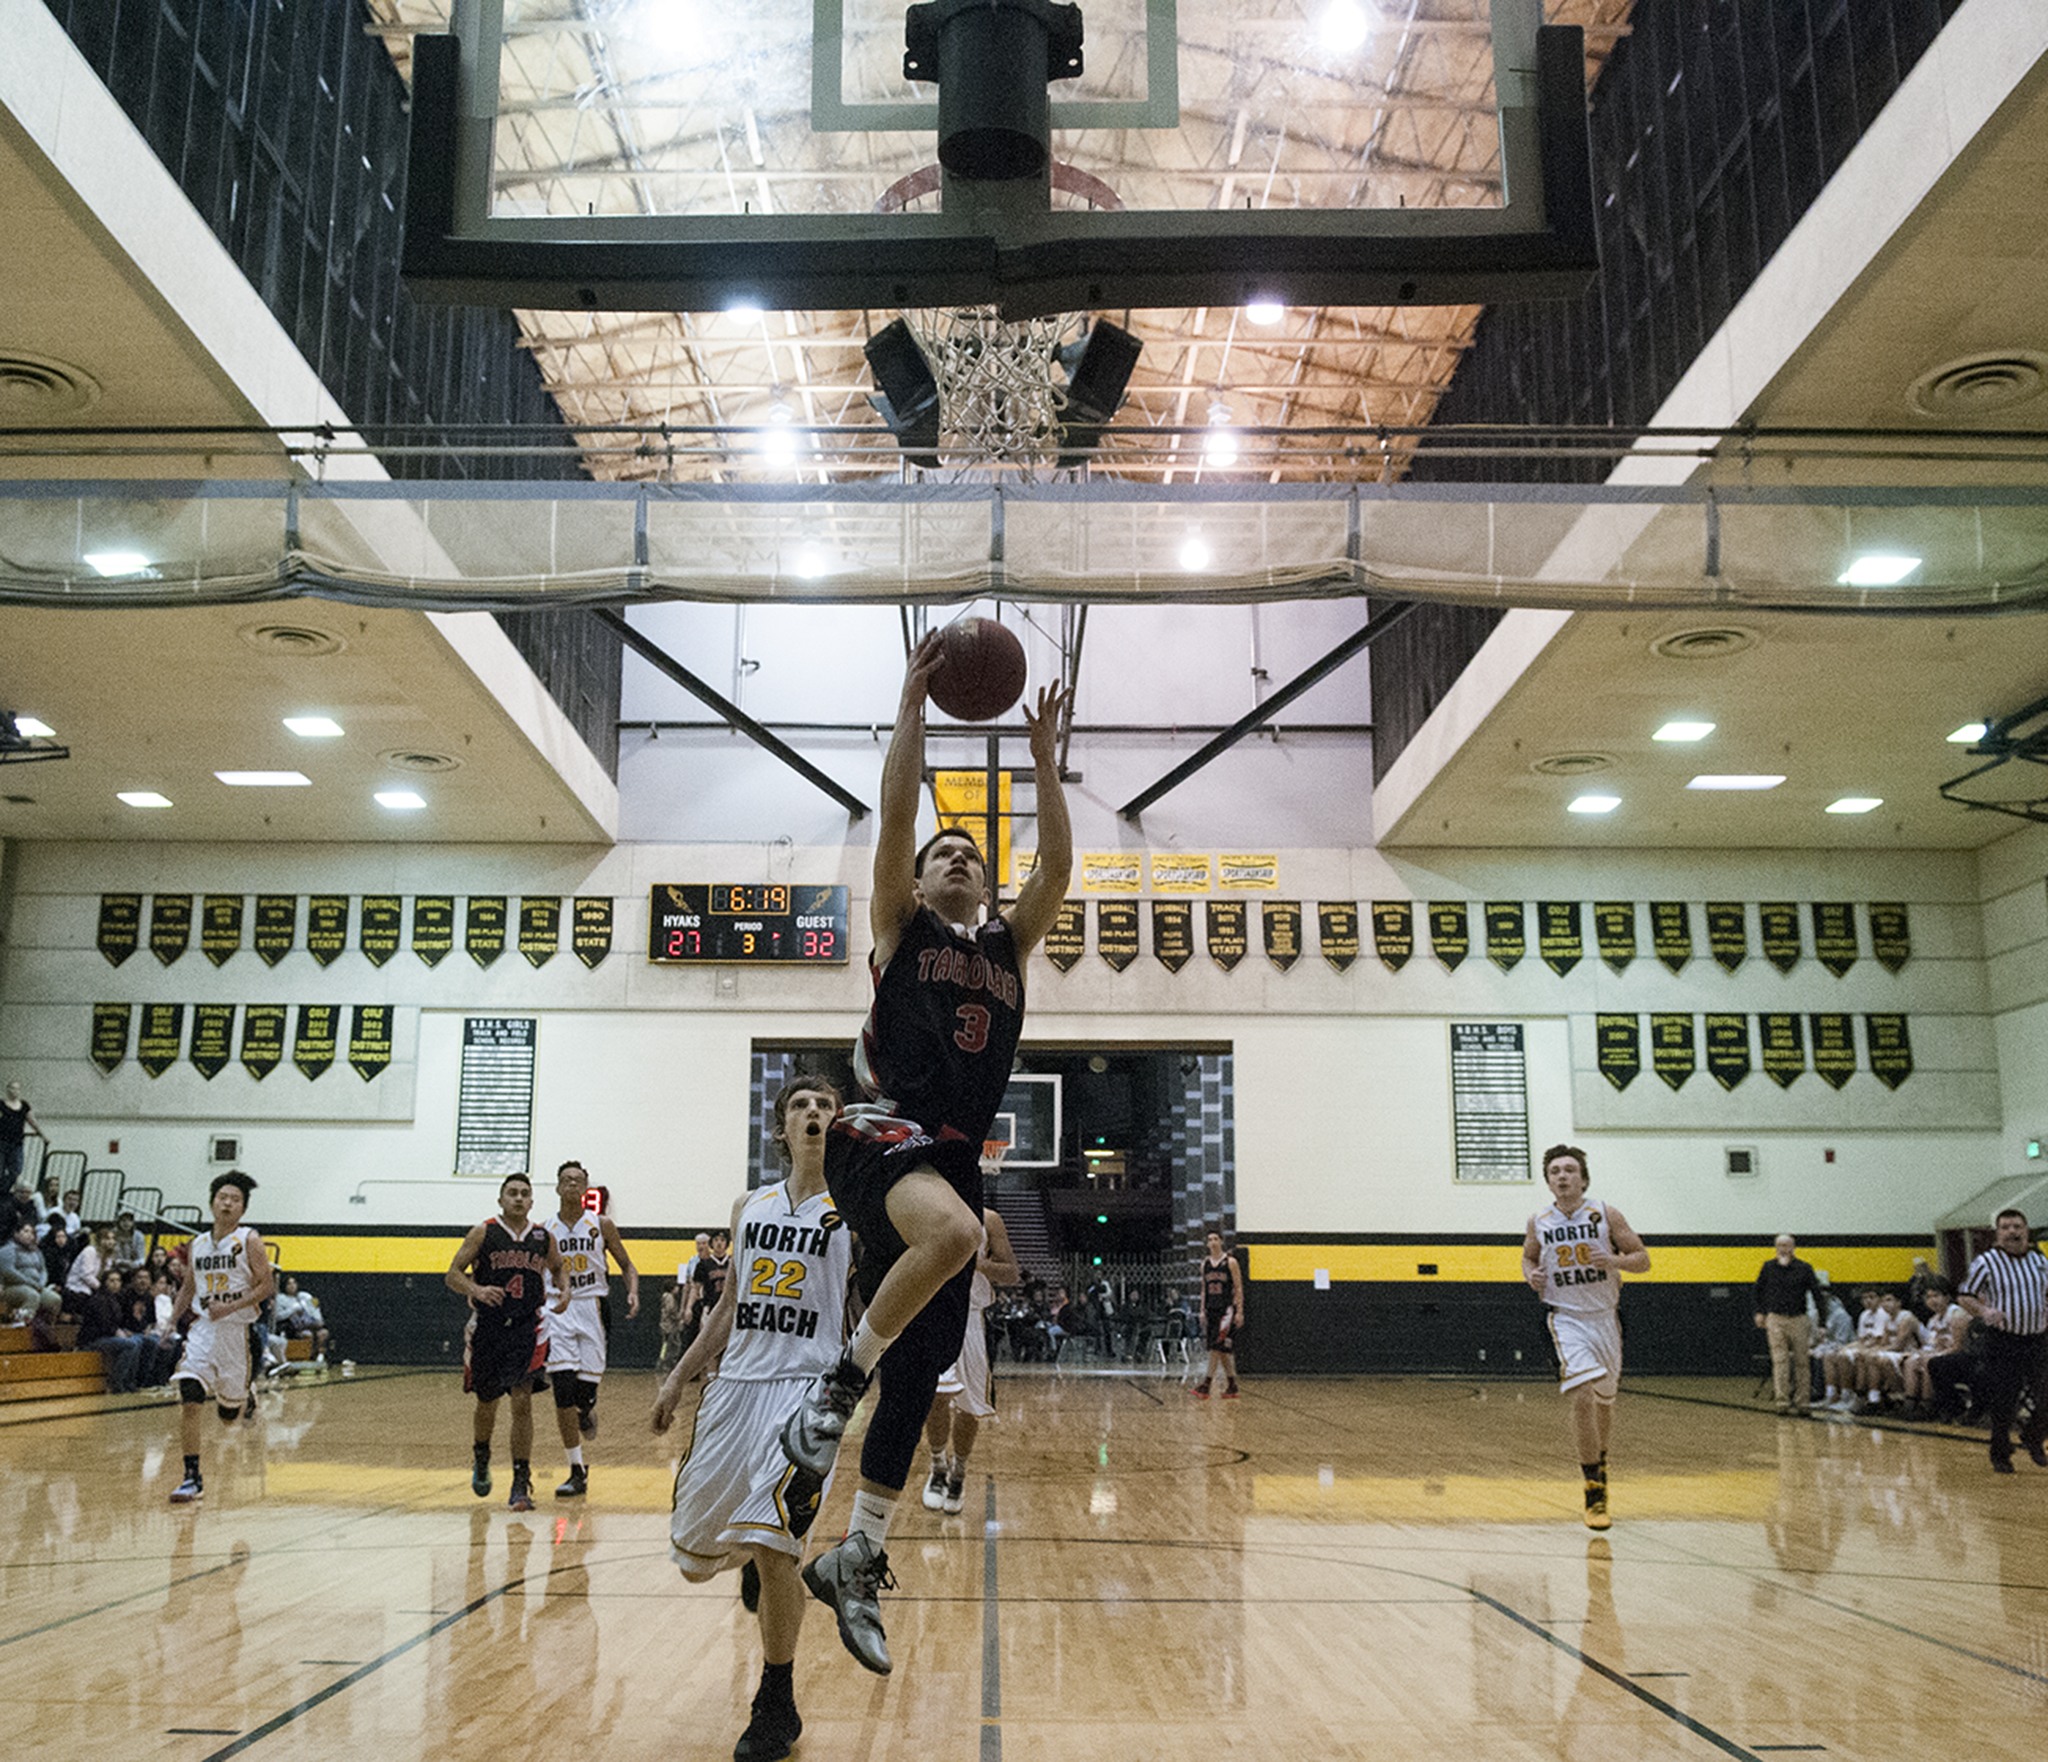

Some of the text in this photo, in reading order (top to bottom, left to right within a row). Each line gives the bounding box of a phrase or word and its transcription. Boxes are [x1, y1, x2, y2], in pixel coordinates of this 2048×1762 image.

[944, 777, 987, 787] MEMB
[730, 886, 785, 911] 6:19
[363, 899, 400, 911] FOOTBALL
[577, 900, 609, 911] SOFTBALL
[1100, 904, 1136, 914] BASEBALL
[1210, 904, 1242, 914] TRACK
[663, 914, 701, 927] HYAKS
[796, 915, 834, 928] GUEST
[590, 925, 611, 933] PLACE
[734, 921, 763, 932] PERIOD
[482, 928, 504, 936] PLACE
[534, 931, 556, 939] PLACE
[470, 938, 500, 948] STATE
[577, 937, 606, 947] STATE
[668, 930, 701, 956] 27
[1061, 934, 1082, 942] PLACE
[1542, 937, 1580, 946] DISTRICT
[311, 940, 341, 949] STATE
[364, 940, 394, 949] STATE
[412, 940, 451, 949] DISTRICT
[519, 942, 557, 952] DISTRICT
[743, 933, 755, 954] 3
[805, 931, 834, 956] 32
[1046, 945, 1083, 954] DISTRICT
[1099, 944, 1137, 954] DISTRICT
[1211, 945, 1242, 954] STATE
[1379, 945, 1408, 955] STATE
[308, 1008, 330, 1018] GOLF
[362, 1008, 384, 1018] GOLF
[506, 1020, 529, 1029] GIRLS
[954, 1003, 991, 1053] 3
[495, 1029, 508, 1037] AND
[297, 1040, 334, 1049] DISTRICT
[351, 1040, 390, 1050] DISTRICT
[1544, 1223, 1599, 1244] NORTH
[745, 1222, 832, 1258] NORTH
[560, 1238, 596, 1253] ORTH
[195, 1255, 237, 1271] NORTH
[205, 1273, 229, 1292] 12
[569, 1272, 596, 1289] ACH
[750, 1256, 808, 1300] 22
[1553, 1268, 1607, 1288] BEACH
[505, 1274, 523, 1298] 4
[736, 1302, 820, 1340] BEACH
